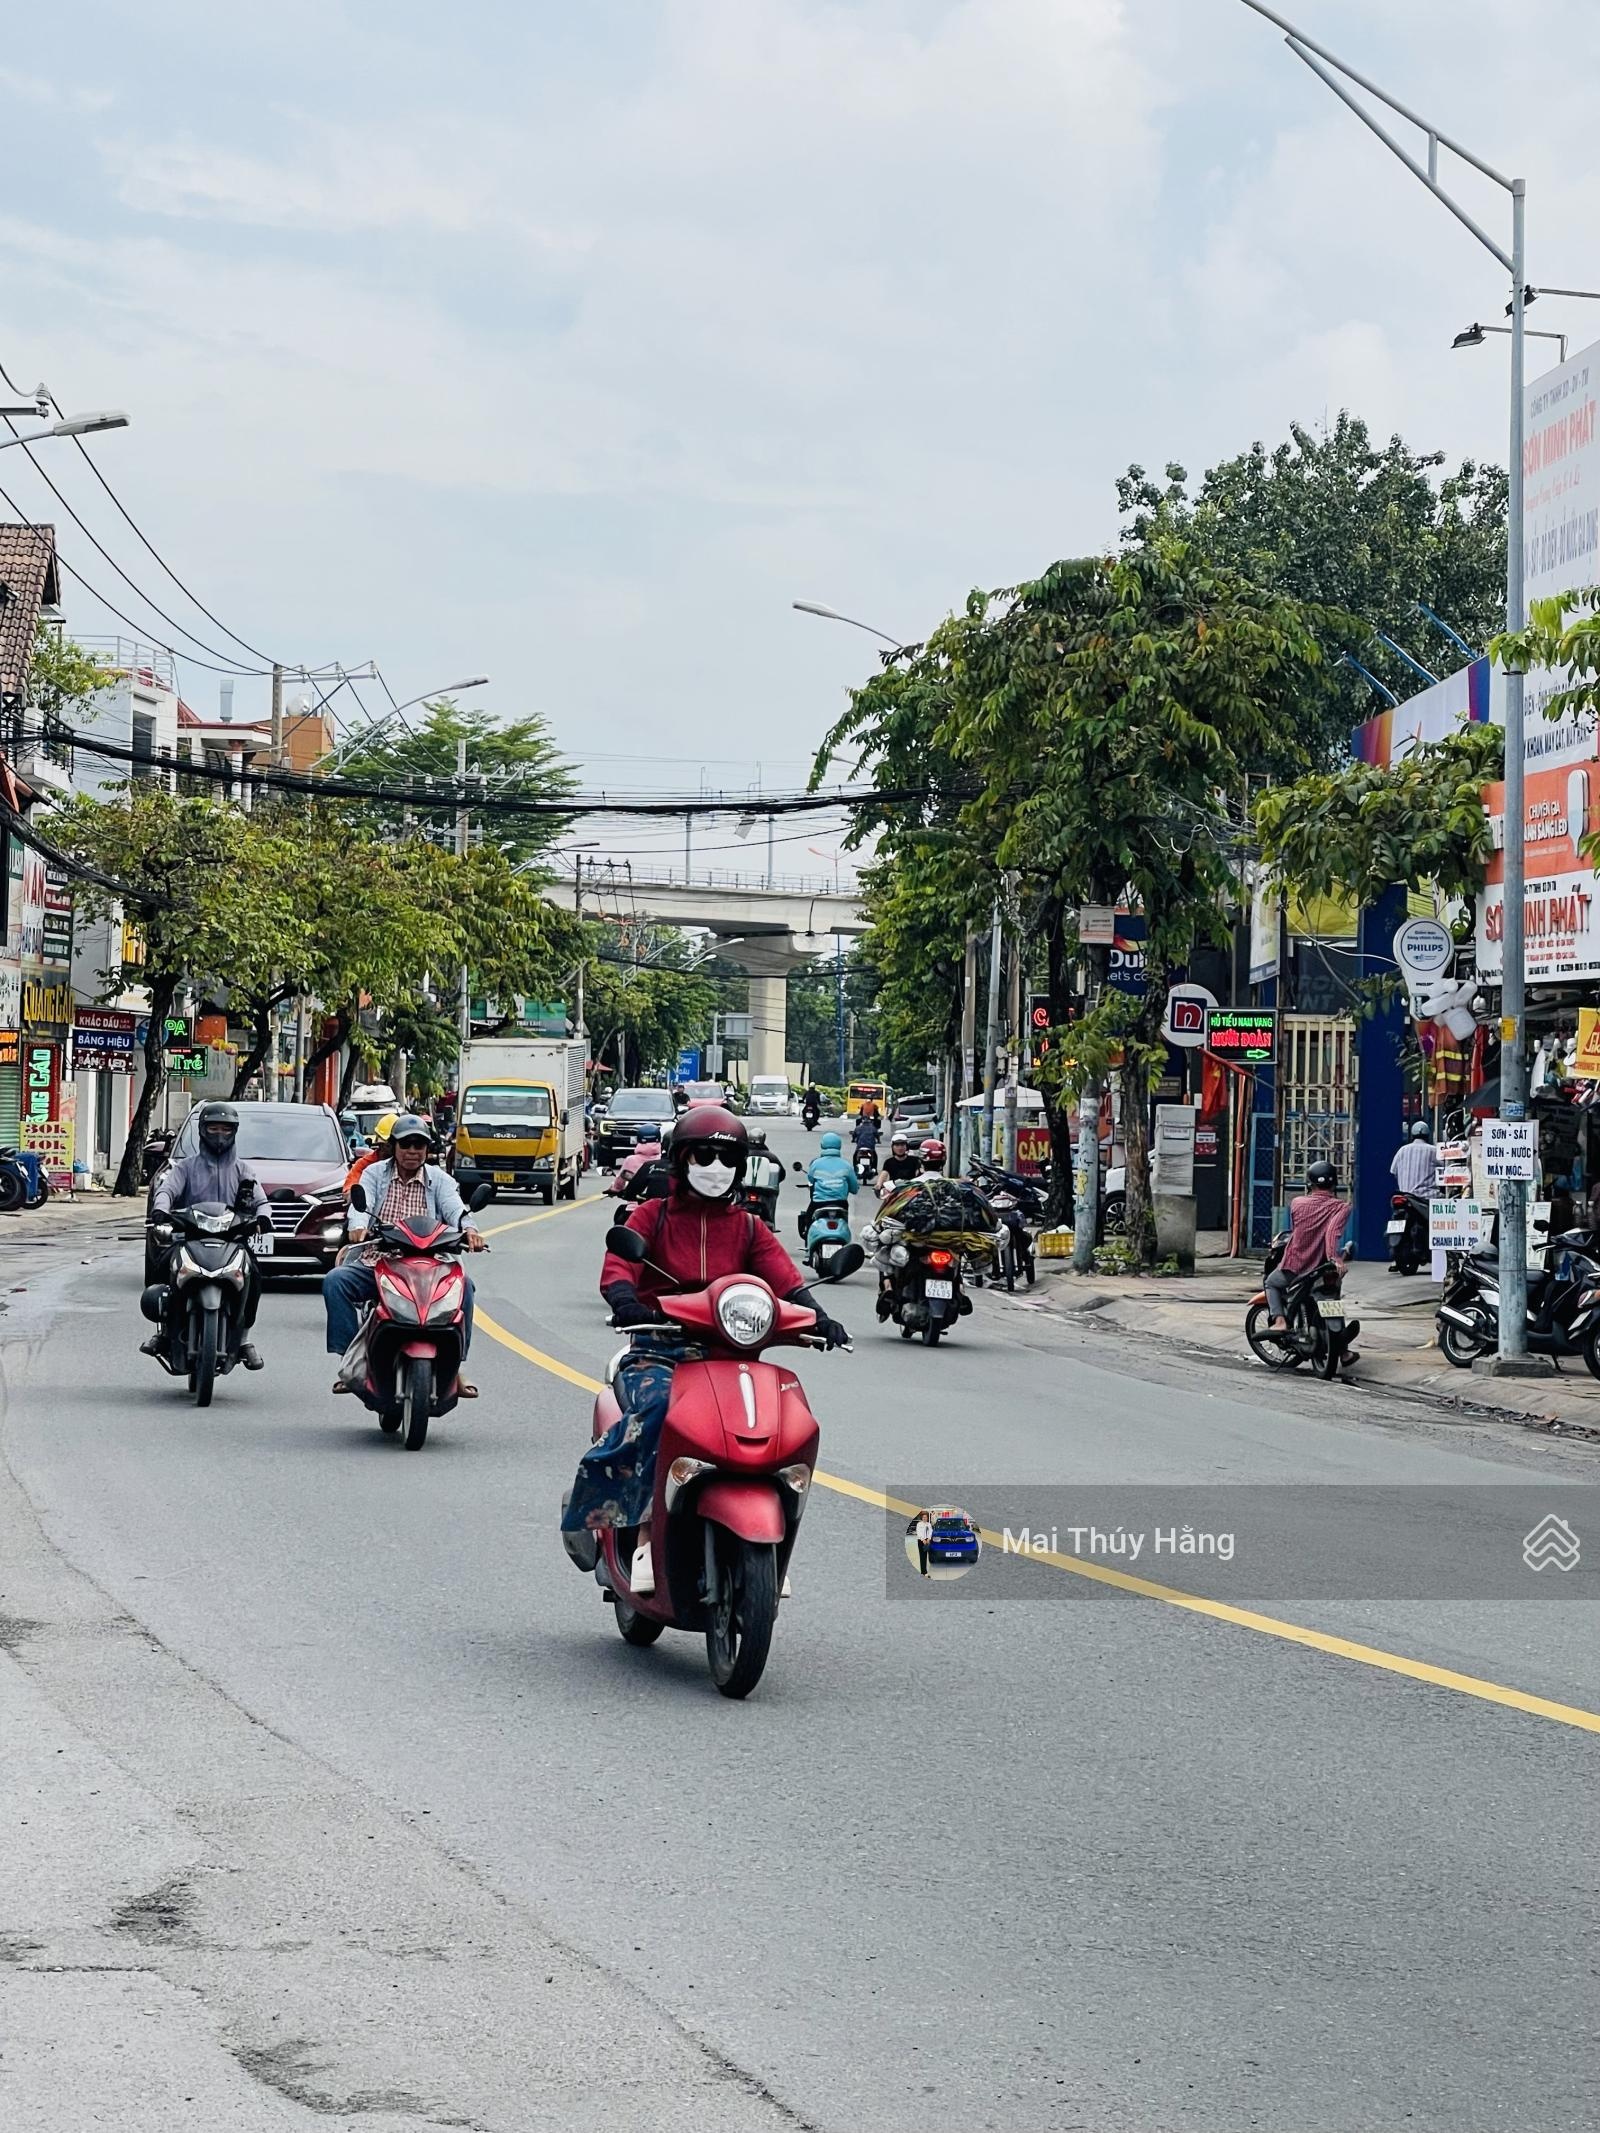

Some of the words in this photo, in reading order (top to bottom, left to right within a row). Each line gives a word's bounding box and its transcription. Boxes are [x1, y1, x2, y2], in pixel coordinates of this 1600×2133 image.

[1569, 393, 1596, 453] PHÁT
[1525, 899, 1546, 937] INH
[1407, 943, 1444, 952] PHILIPS
[79, 1013, 101, 1027] KHÁC
[103, 1016, 119, 1028] DẤU
[1254, 1017, 1272, 1027] VANG
[78, 1032, 104, 1046] BẢNG
[107, 1035, 130, 1049] HIỆU
[1491, 1128, 1506, 1140] SƠN
[1511, 1146, 1532, 1158] NƯỚC
[1488, 1163, 1503, 1176] MÁY
[1432, 1237, 1453, 1247] CHANH
